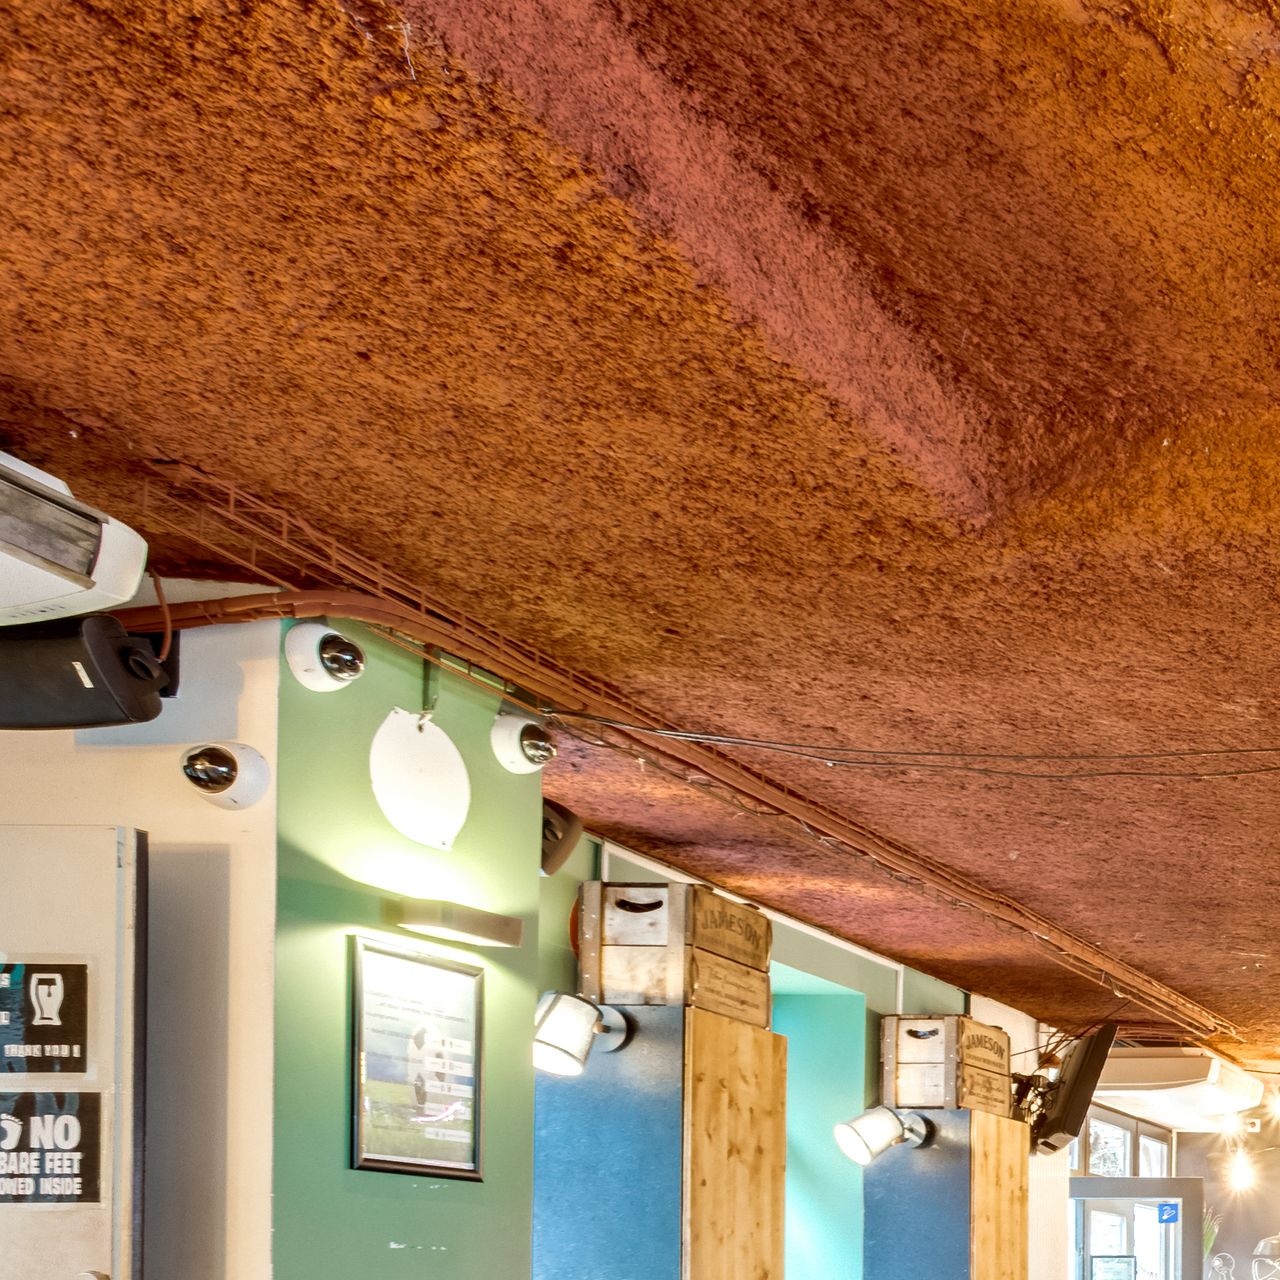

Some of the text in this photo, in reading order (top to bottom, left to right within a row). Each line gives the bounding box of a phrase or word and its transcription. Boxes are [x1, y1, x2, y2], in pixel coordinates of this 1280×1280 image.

[966, 1034, 1006, 1060] JAMESON
[29, 1114, 82, 1150] NO
[44, 1151, 82, 1175] FEET
[39, 1177, 82, 1195] INSIDE
